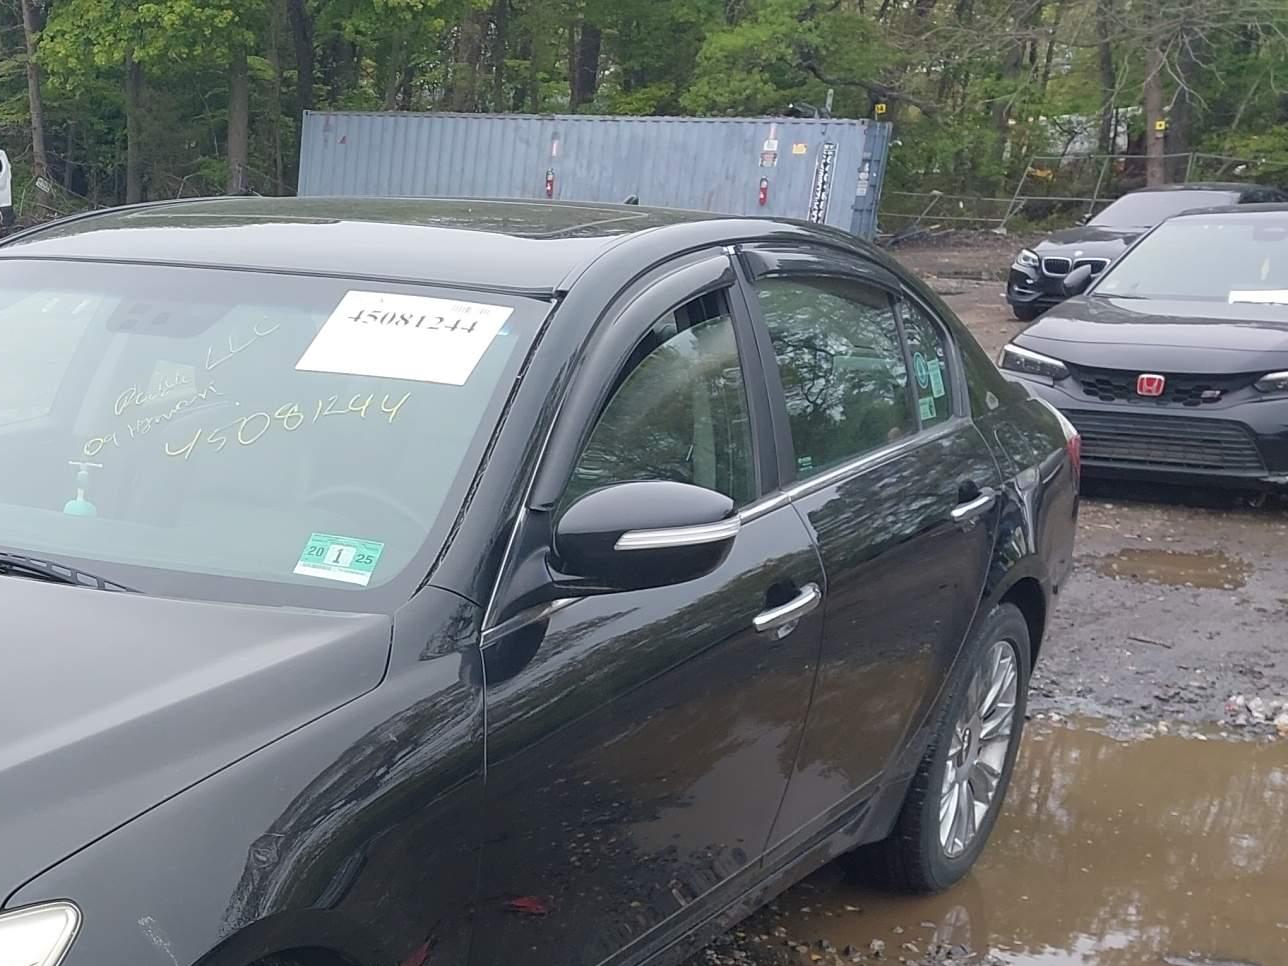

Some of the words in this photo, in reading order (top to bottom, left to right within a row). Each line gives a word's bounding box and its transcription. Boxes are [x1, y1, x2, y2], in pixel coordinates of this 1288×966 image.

[347, 309, 479, 333] 45081244
[165, 393, 411, 459] 45081244
[308, 546, 324, 557] 20
[332, 548, 342, 564] 1
[355, 554, 373, 565] 25
